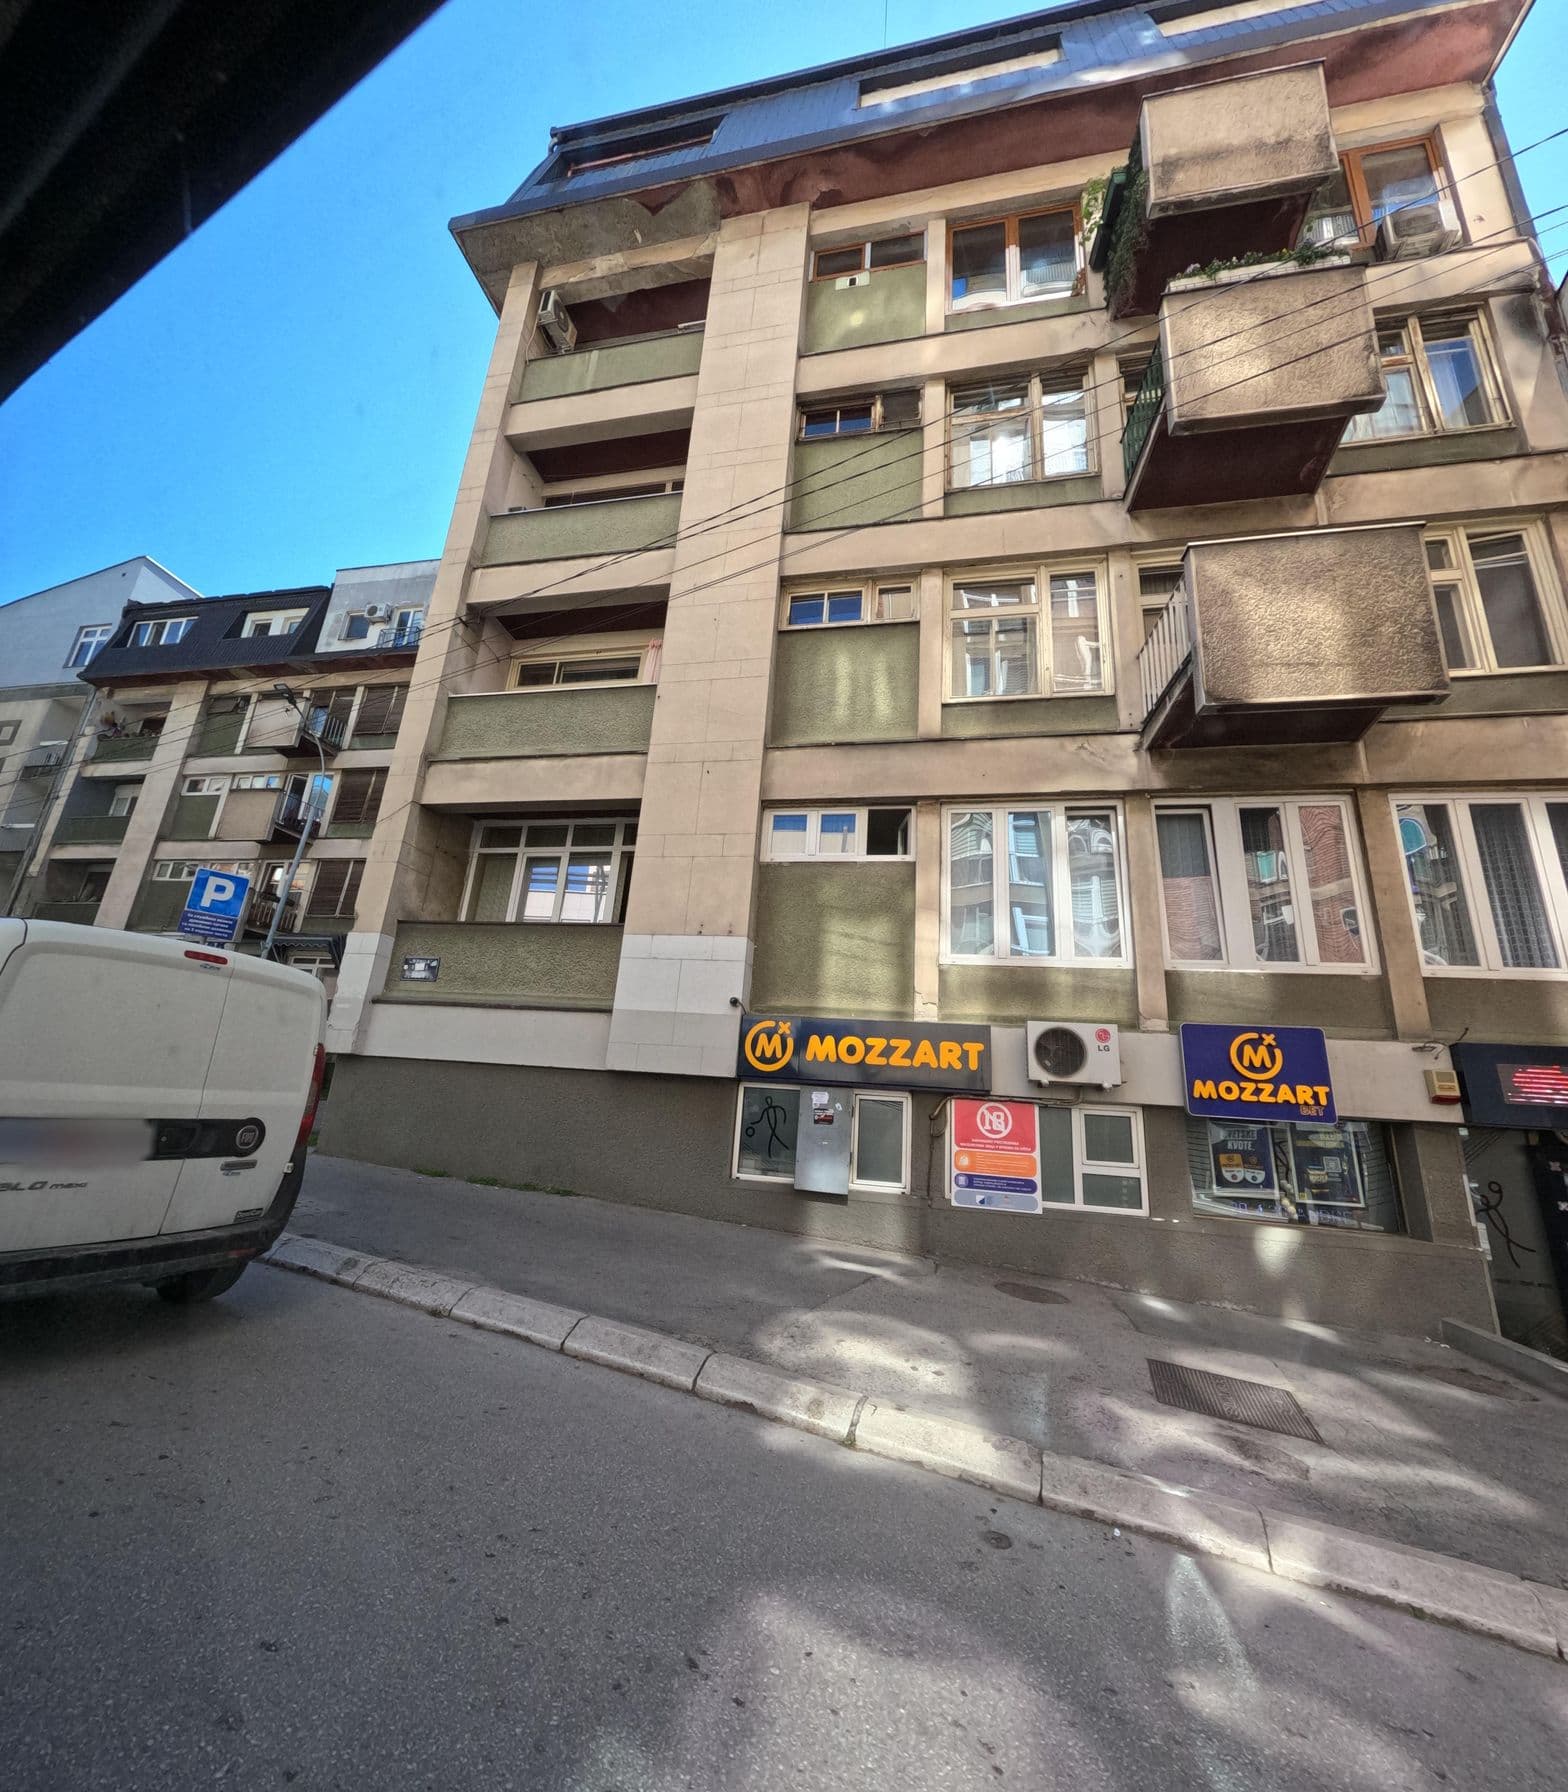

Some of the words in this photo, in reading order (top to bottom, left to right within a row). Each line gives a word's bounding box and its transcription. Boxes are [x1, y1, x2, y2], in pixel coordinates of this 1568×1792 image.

[201, 876, 235, 907] P
[805, 1034, 985, 1071] MOZZART
[1193, 1080, 1330, 1105] MOZZART
[1300, 1105, 1325, 1116] BET
